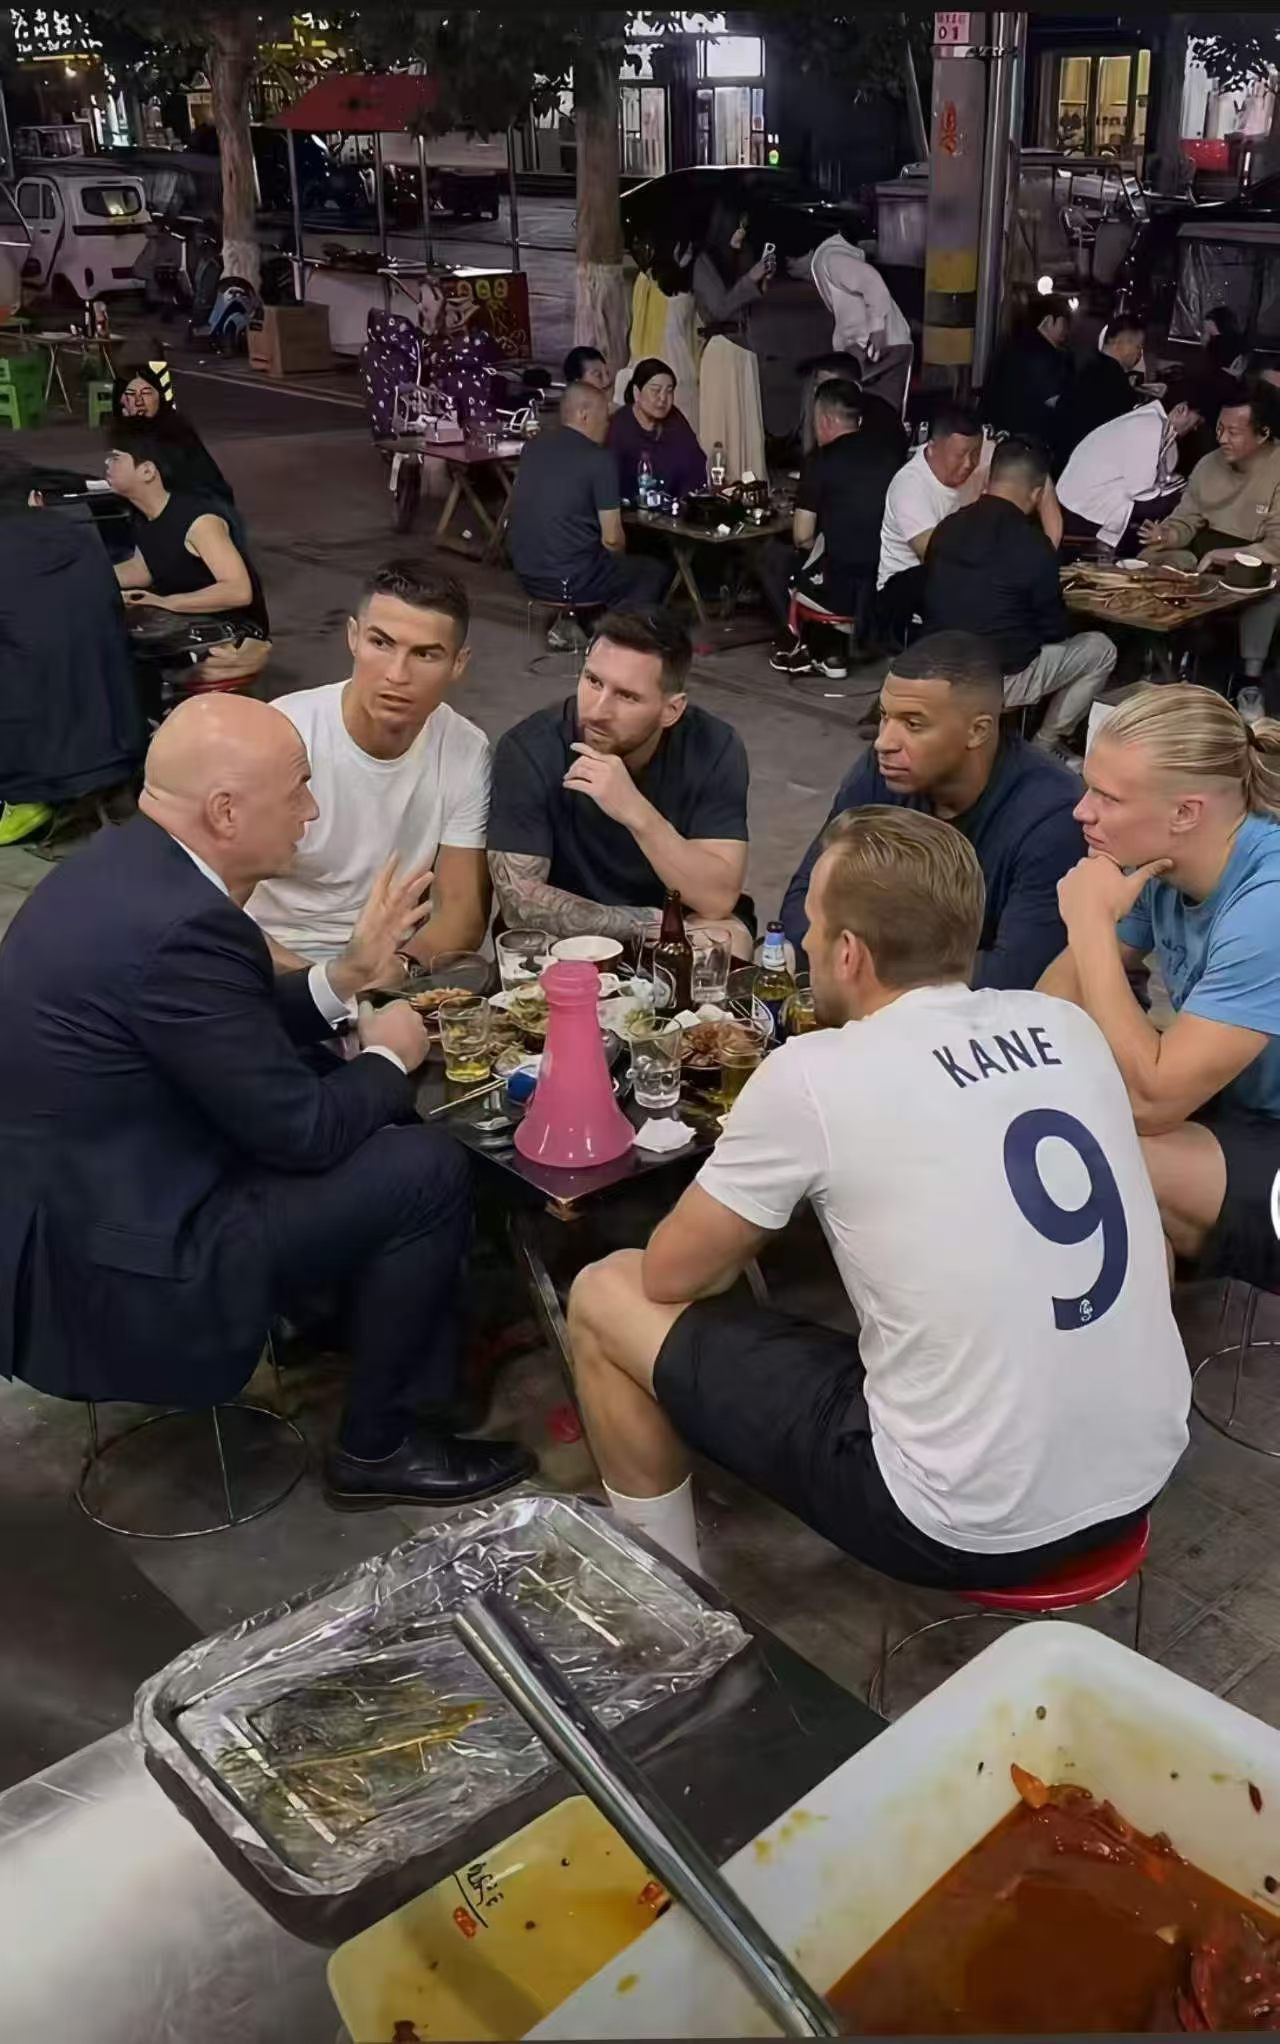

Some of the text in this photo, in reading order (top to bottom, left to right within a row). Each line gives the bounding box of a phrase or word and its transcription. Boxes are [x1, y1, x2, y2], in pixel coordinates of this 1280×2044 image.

[938, 26, 959, 40] 01
[932, 1027, 1062, 1088] KANE
[1003, 1108, 1129, 1331] 9
